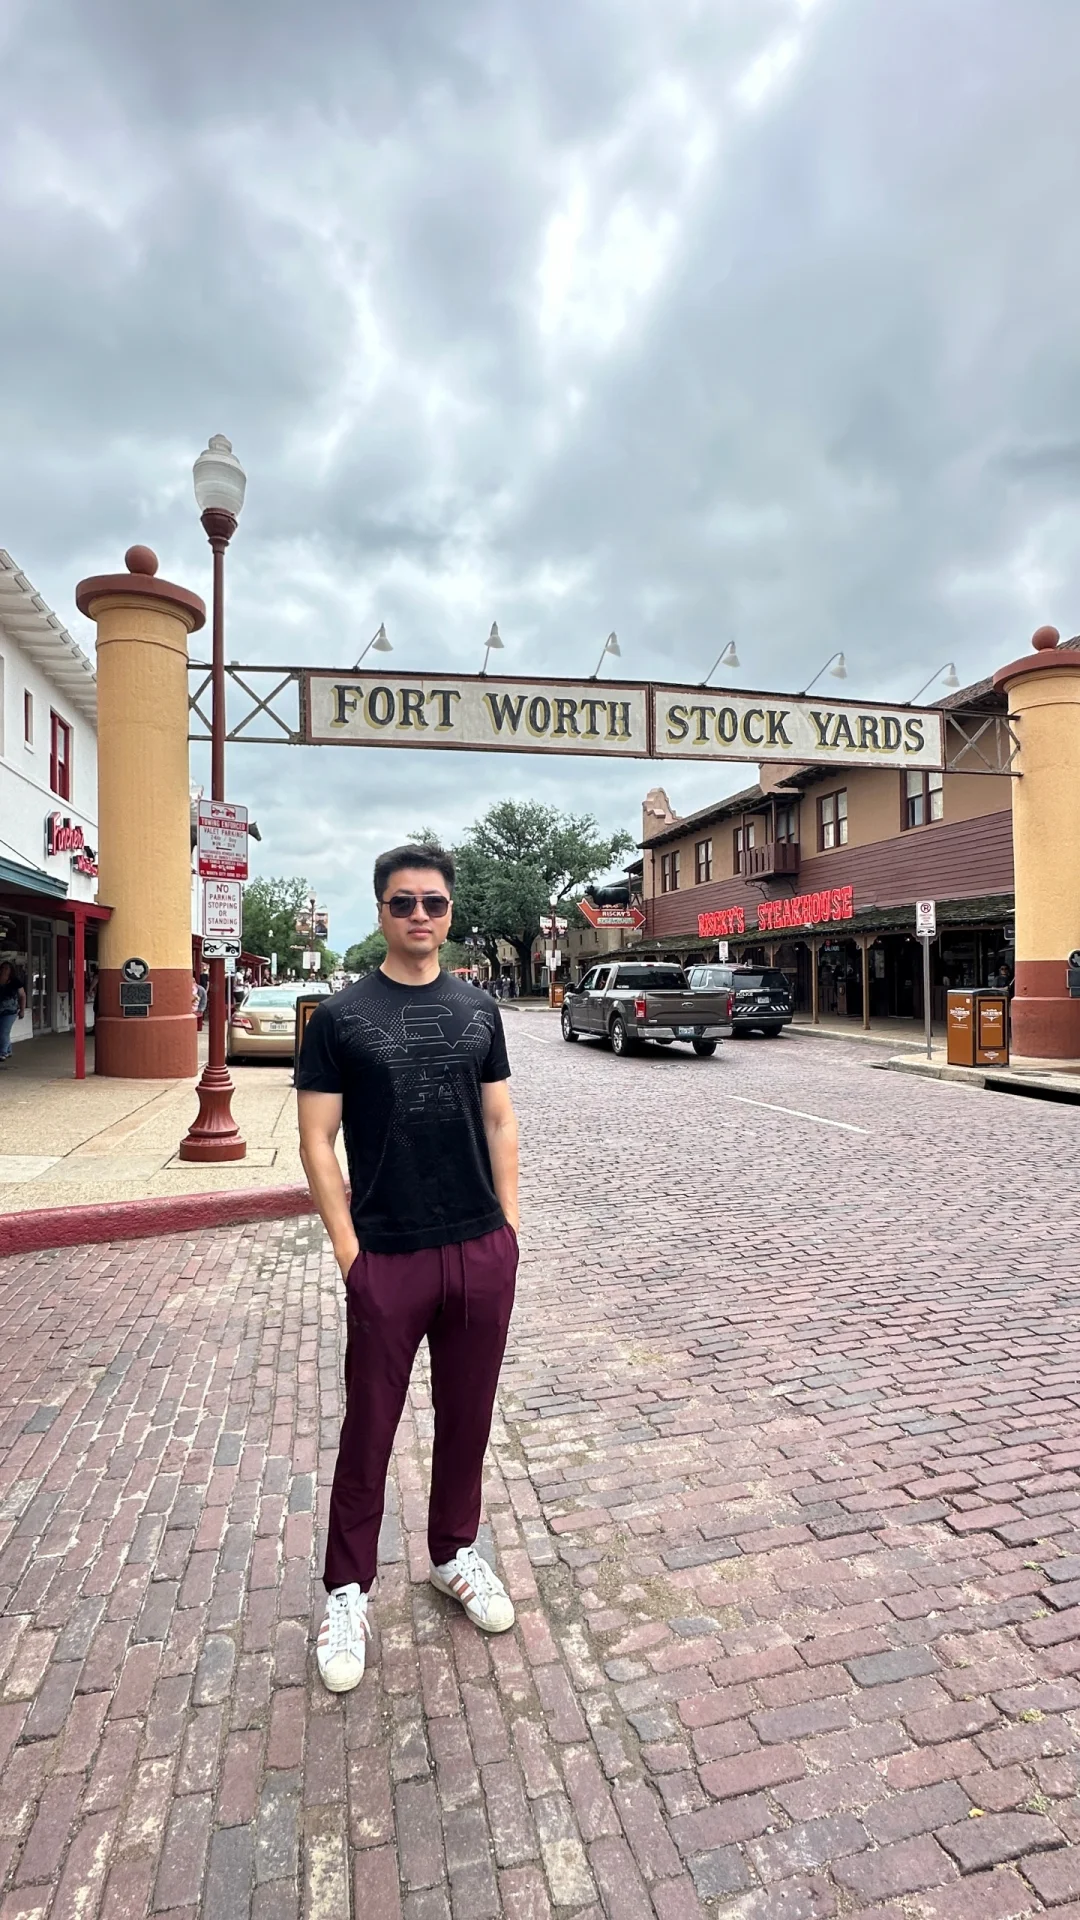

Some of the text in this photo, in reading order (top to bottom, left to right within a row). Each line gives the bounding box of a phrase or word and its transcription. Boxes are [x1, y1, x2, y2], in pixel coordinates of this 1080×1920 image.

[330, 684, 633, 741] FORT WORTH
[665, 704, 925, 754] STOCK YARDS
[201, 818, 245, 830] TOWING ENFORCED
[203, 827, 244, 838] VALET PARKING
[216, 885, 229, 893] NO
[757, 884, 854, 931] STEAKHOUSE
